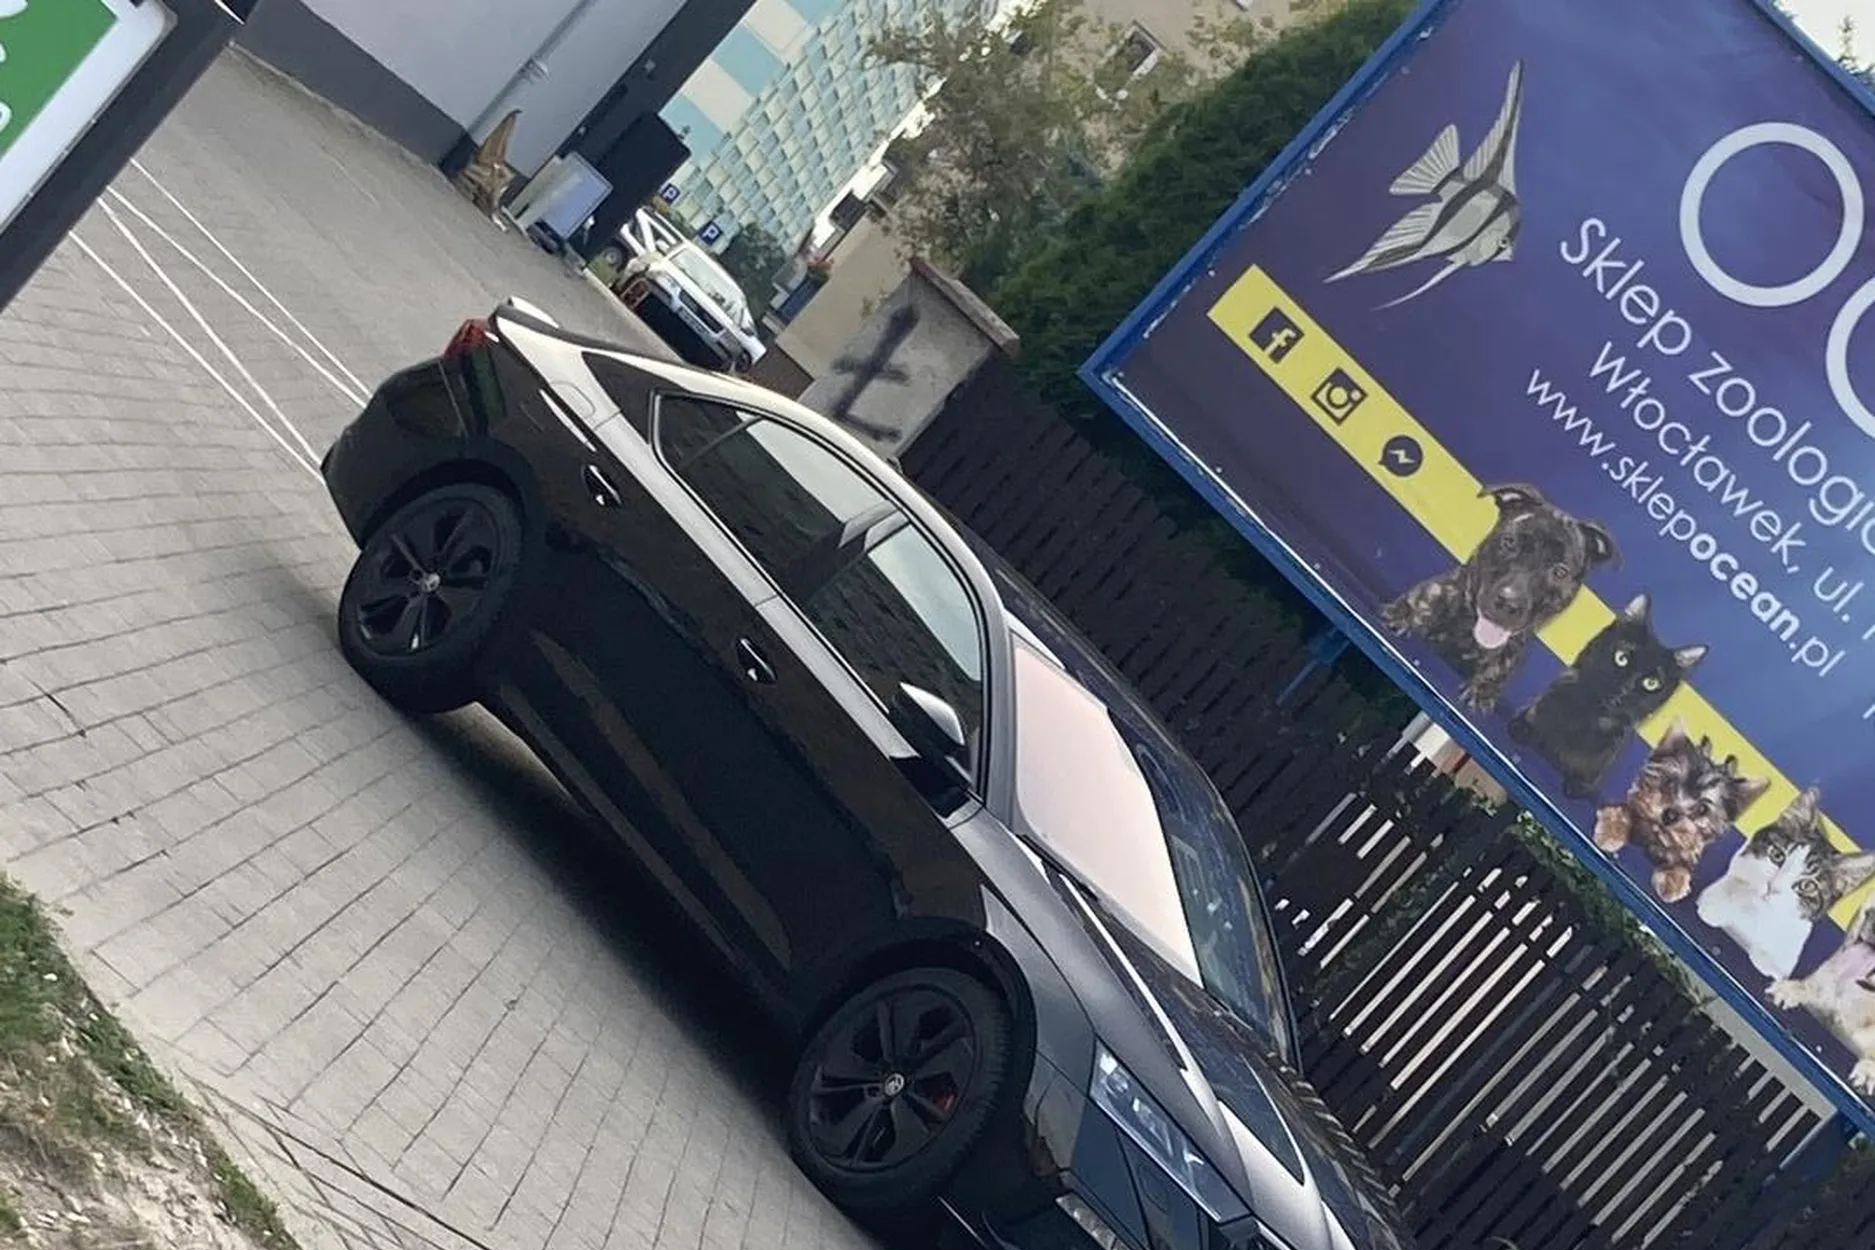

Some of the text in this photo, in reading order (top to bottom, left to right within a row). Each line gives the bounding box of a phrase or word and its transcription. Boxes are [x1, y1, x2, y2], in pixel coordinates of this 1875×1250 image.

[1559, 217, 1691, 357] Sklep
[1525, 369, 1846, 677] www.sklepocean.pl
[1589, 341, 1865, 623] Włocławek, ul.
